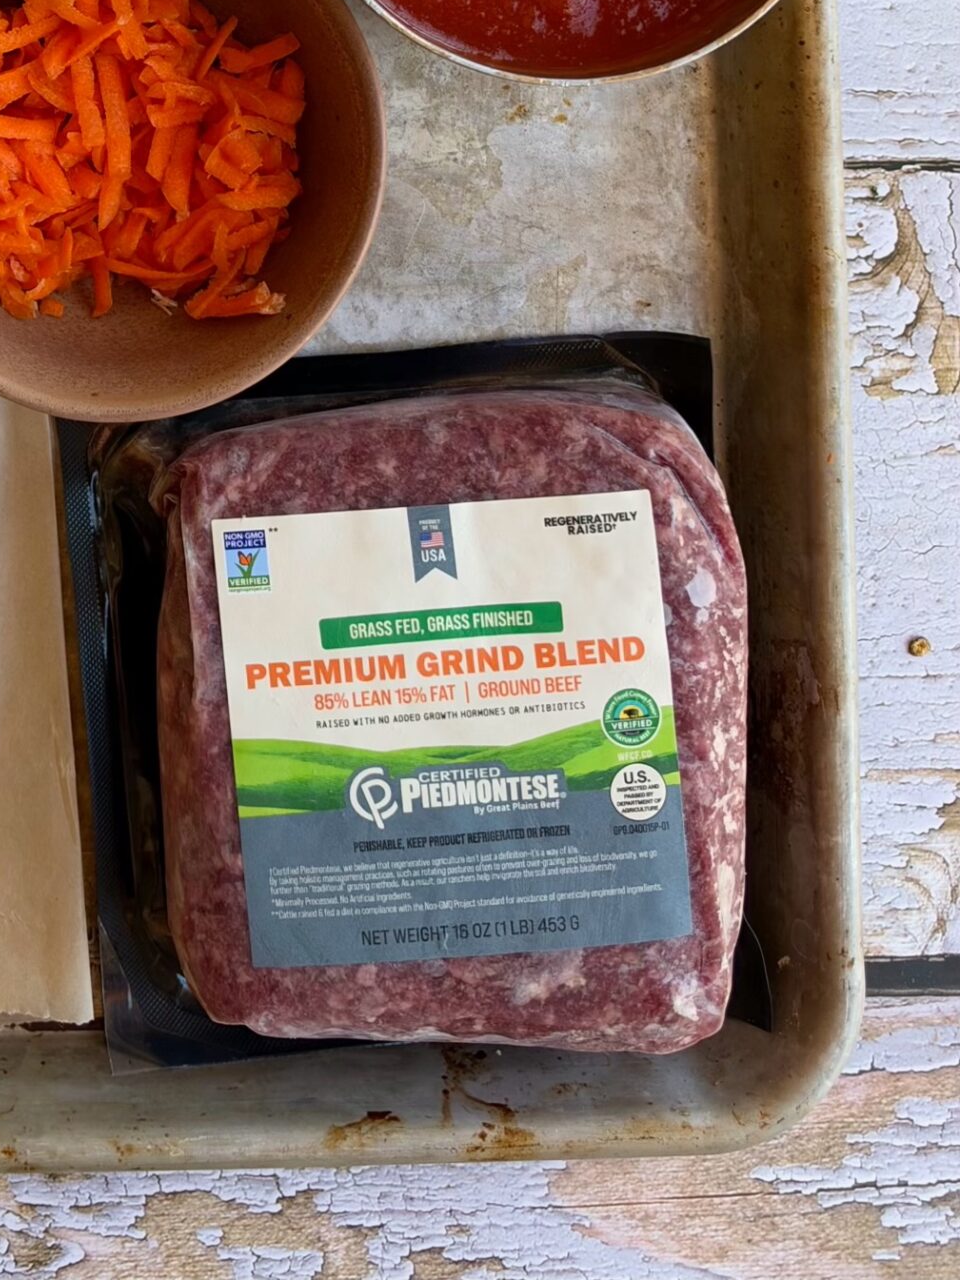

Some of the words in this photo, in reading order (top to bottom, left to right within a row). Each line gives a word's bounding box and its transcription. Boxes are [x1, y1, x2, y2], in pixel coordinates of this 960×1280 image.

[544, 511, 638, 527] REGENERATIVELY
[225, 539, 264, 548] PROJECT
[421, 549, 446, 562] USA
[230, 577, 268, 586] VERIFIED
[349, 622, 392, 640] GRASS
[395, 618, 424, 635] FED,
[427, 614, 470, 632] GRASS
[472, 610, 533, 629] FINISHED
[245, 654, 407, 690] PREMIUM
[416, 645, 524, 677] GRIND
[534, 636, 645, 668] BLEND
[314, 693, 349, 710] 85%
[352, 690, 392, 707] LEAN
[395, 687, 426, 704] 15%
[431, 684, 456, 702] FAT
[478, 678, 540, 699] GROUND
[545, 675, 582, 693] BEEF
[316, 718, 350, 729] RAISED
[354, 716, 375, 727] WITH
[378, 716, 390, 724] NO
[393, 713, 421, 724] ADDED
[424, 710, 458, 721] GROWTH
[460, 707, 506, 719] HORMONES
[509, 706, 520, 715] OR
[524, 701, 586, 713] ANTIBIOTICS
[611, 720, 652, 730] VERIFIED
[418, 768, 500, 783] CERTIFIED
[624, 770, 651, 784] U.S.
[474, 806, 485, 815] By
[486, 804, 510, 813] Great
[512, 801, 538, 811] Plains
[540, 800, 560, 810] Beef
[354, 840, 405, 853] PERISHABLE,
[407, 838, 428, 849] KEEP
[429, 834, 465, 847] PRODUCT
[468, 828, 525, 843] REFRIGERATED
[527, 828, 538, 838] OR
[540, 825, 571, 837] FROZEN
[362, 929, 389, 946] NET
[393, 925, 449, 944] WEIGHT
[453, 925, 469, 939] 16
[473, 923, 491, 938] OZ
[537, 916, 566, 933] 453
[570, 915, 580, 931] G
